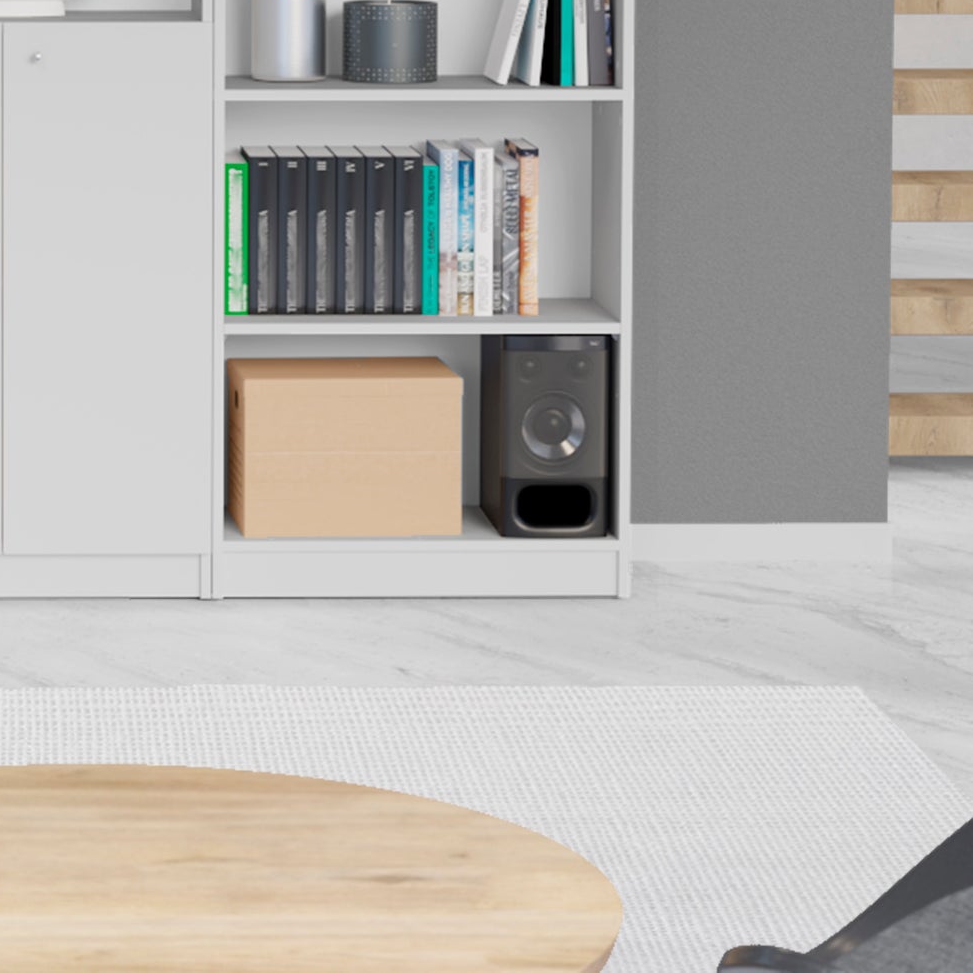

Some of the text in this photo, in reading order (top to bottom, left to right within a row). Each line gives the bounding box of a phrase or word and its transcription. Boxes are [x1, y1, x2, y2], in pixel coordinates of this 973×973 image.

[316, 161, 327, 171] III
[345, 161, 355, 172] IV
[374, 161, 385, 170] V
[403, 160, 414, 171] VI
[427, 169, 435, 207] TOLSTOY
[505, 169, 518, 203] METAL
[427, 221, 435, 254] LEGACY
